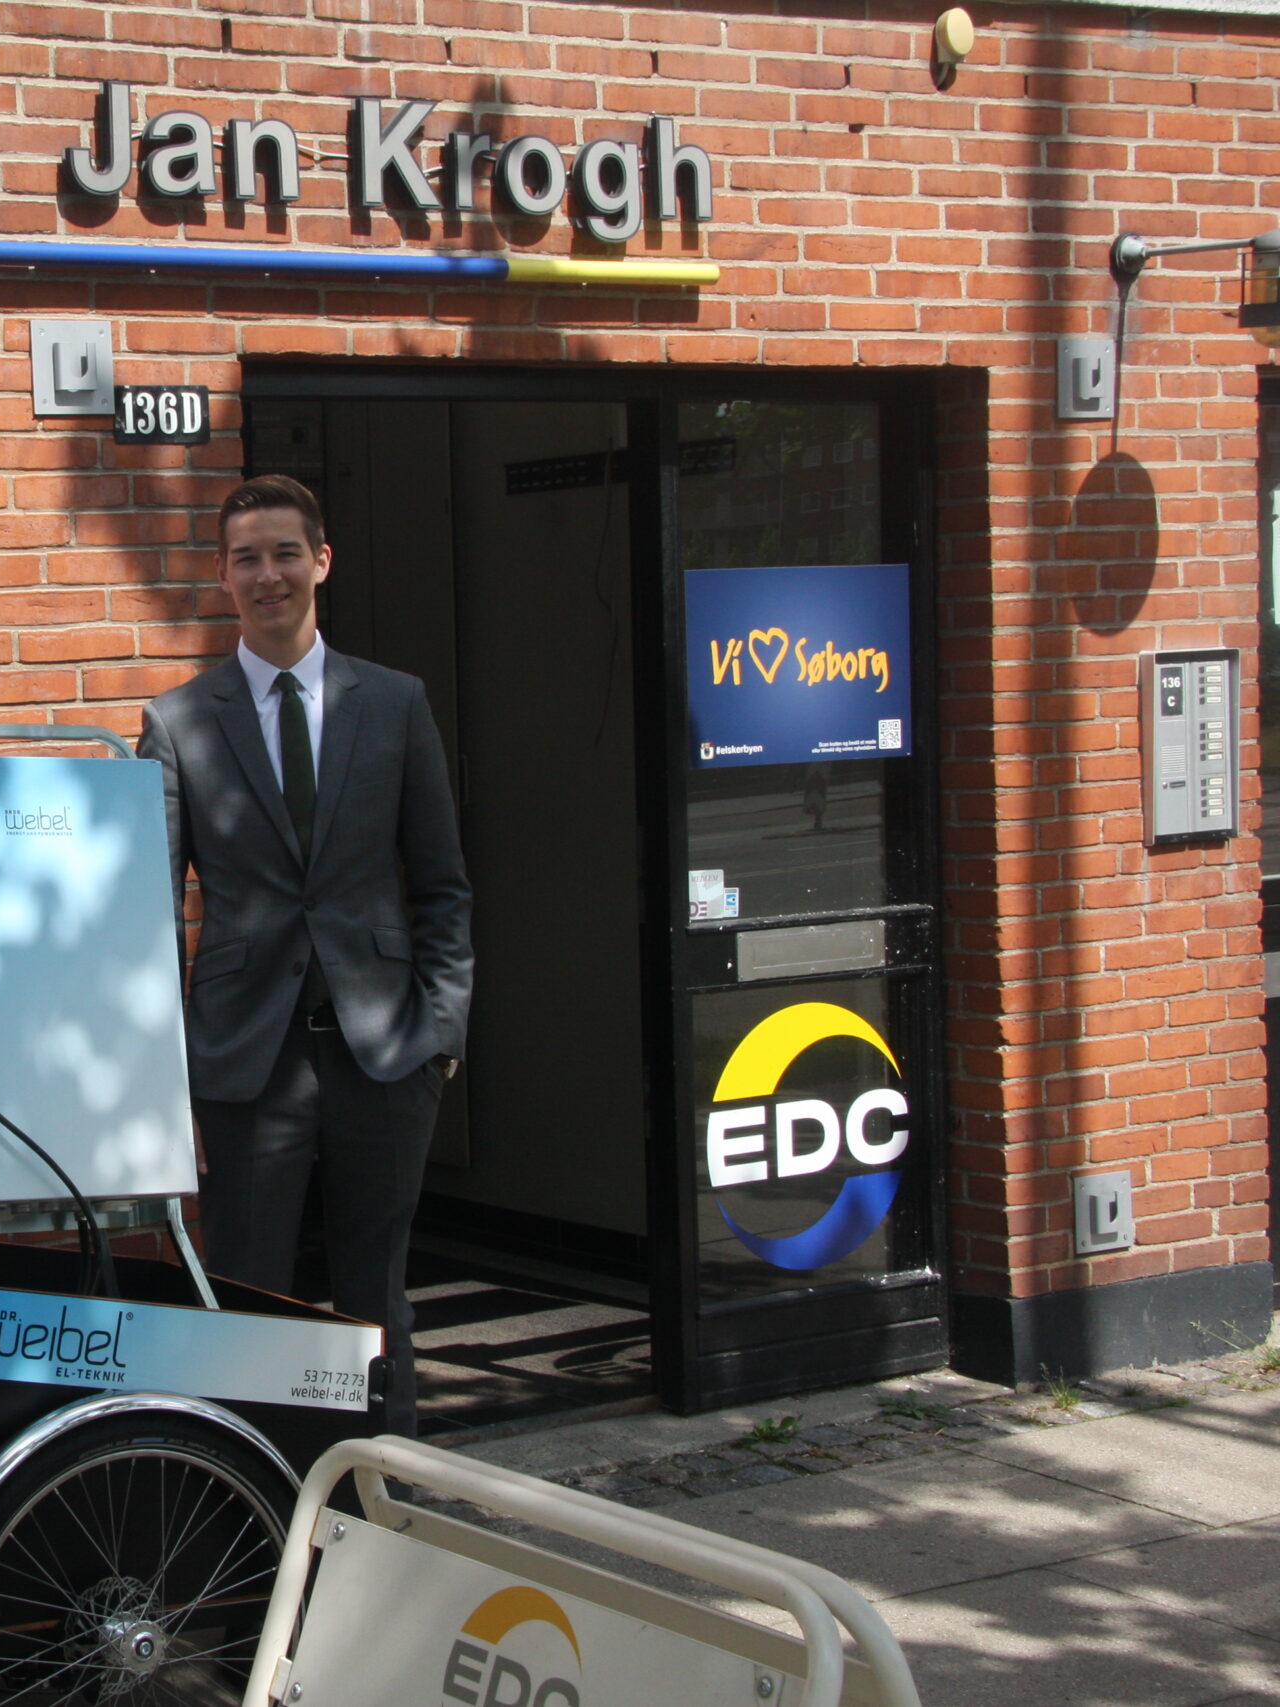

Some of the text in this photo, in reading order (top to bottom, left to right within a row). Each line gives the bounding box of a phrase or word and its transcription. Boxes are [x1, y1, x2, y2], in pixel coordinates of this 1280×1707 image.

[64, 81, 713, 243] Jan Krogh
[122, 392, 202, 435] 136D
[709, 637, 890, 693] Vi Søborg
[1161, 676, 1181, 689] 136
[1167, 695, 1176, 707] C
[707, 1088, 909, 1187] EDC
[55, 1366, 126, 1383] EL-TEKNIK
[304, 1369, 318, 1383] 53
[335, 1372, 349, 1386] 72
[351, 1373, 365, 1387] 73
[291, 1385, 363, 1403] weibel-el.dk
